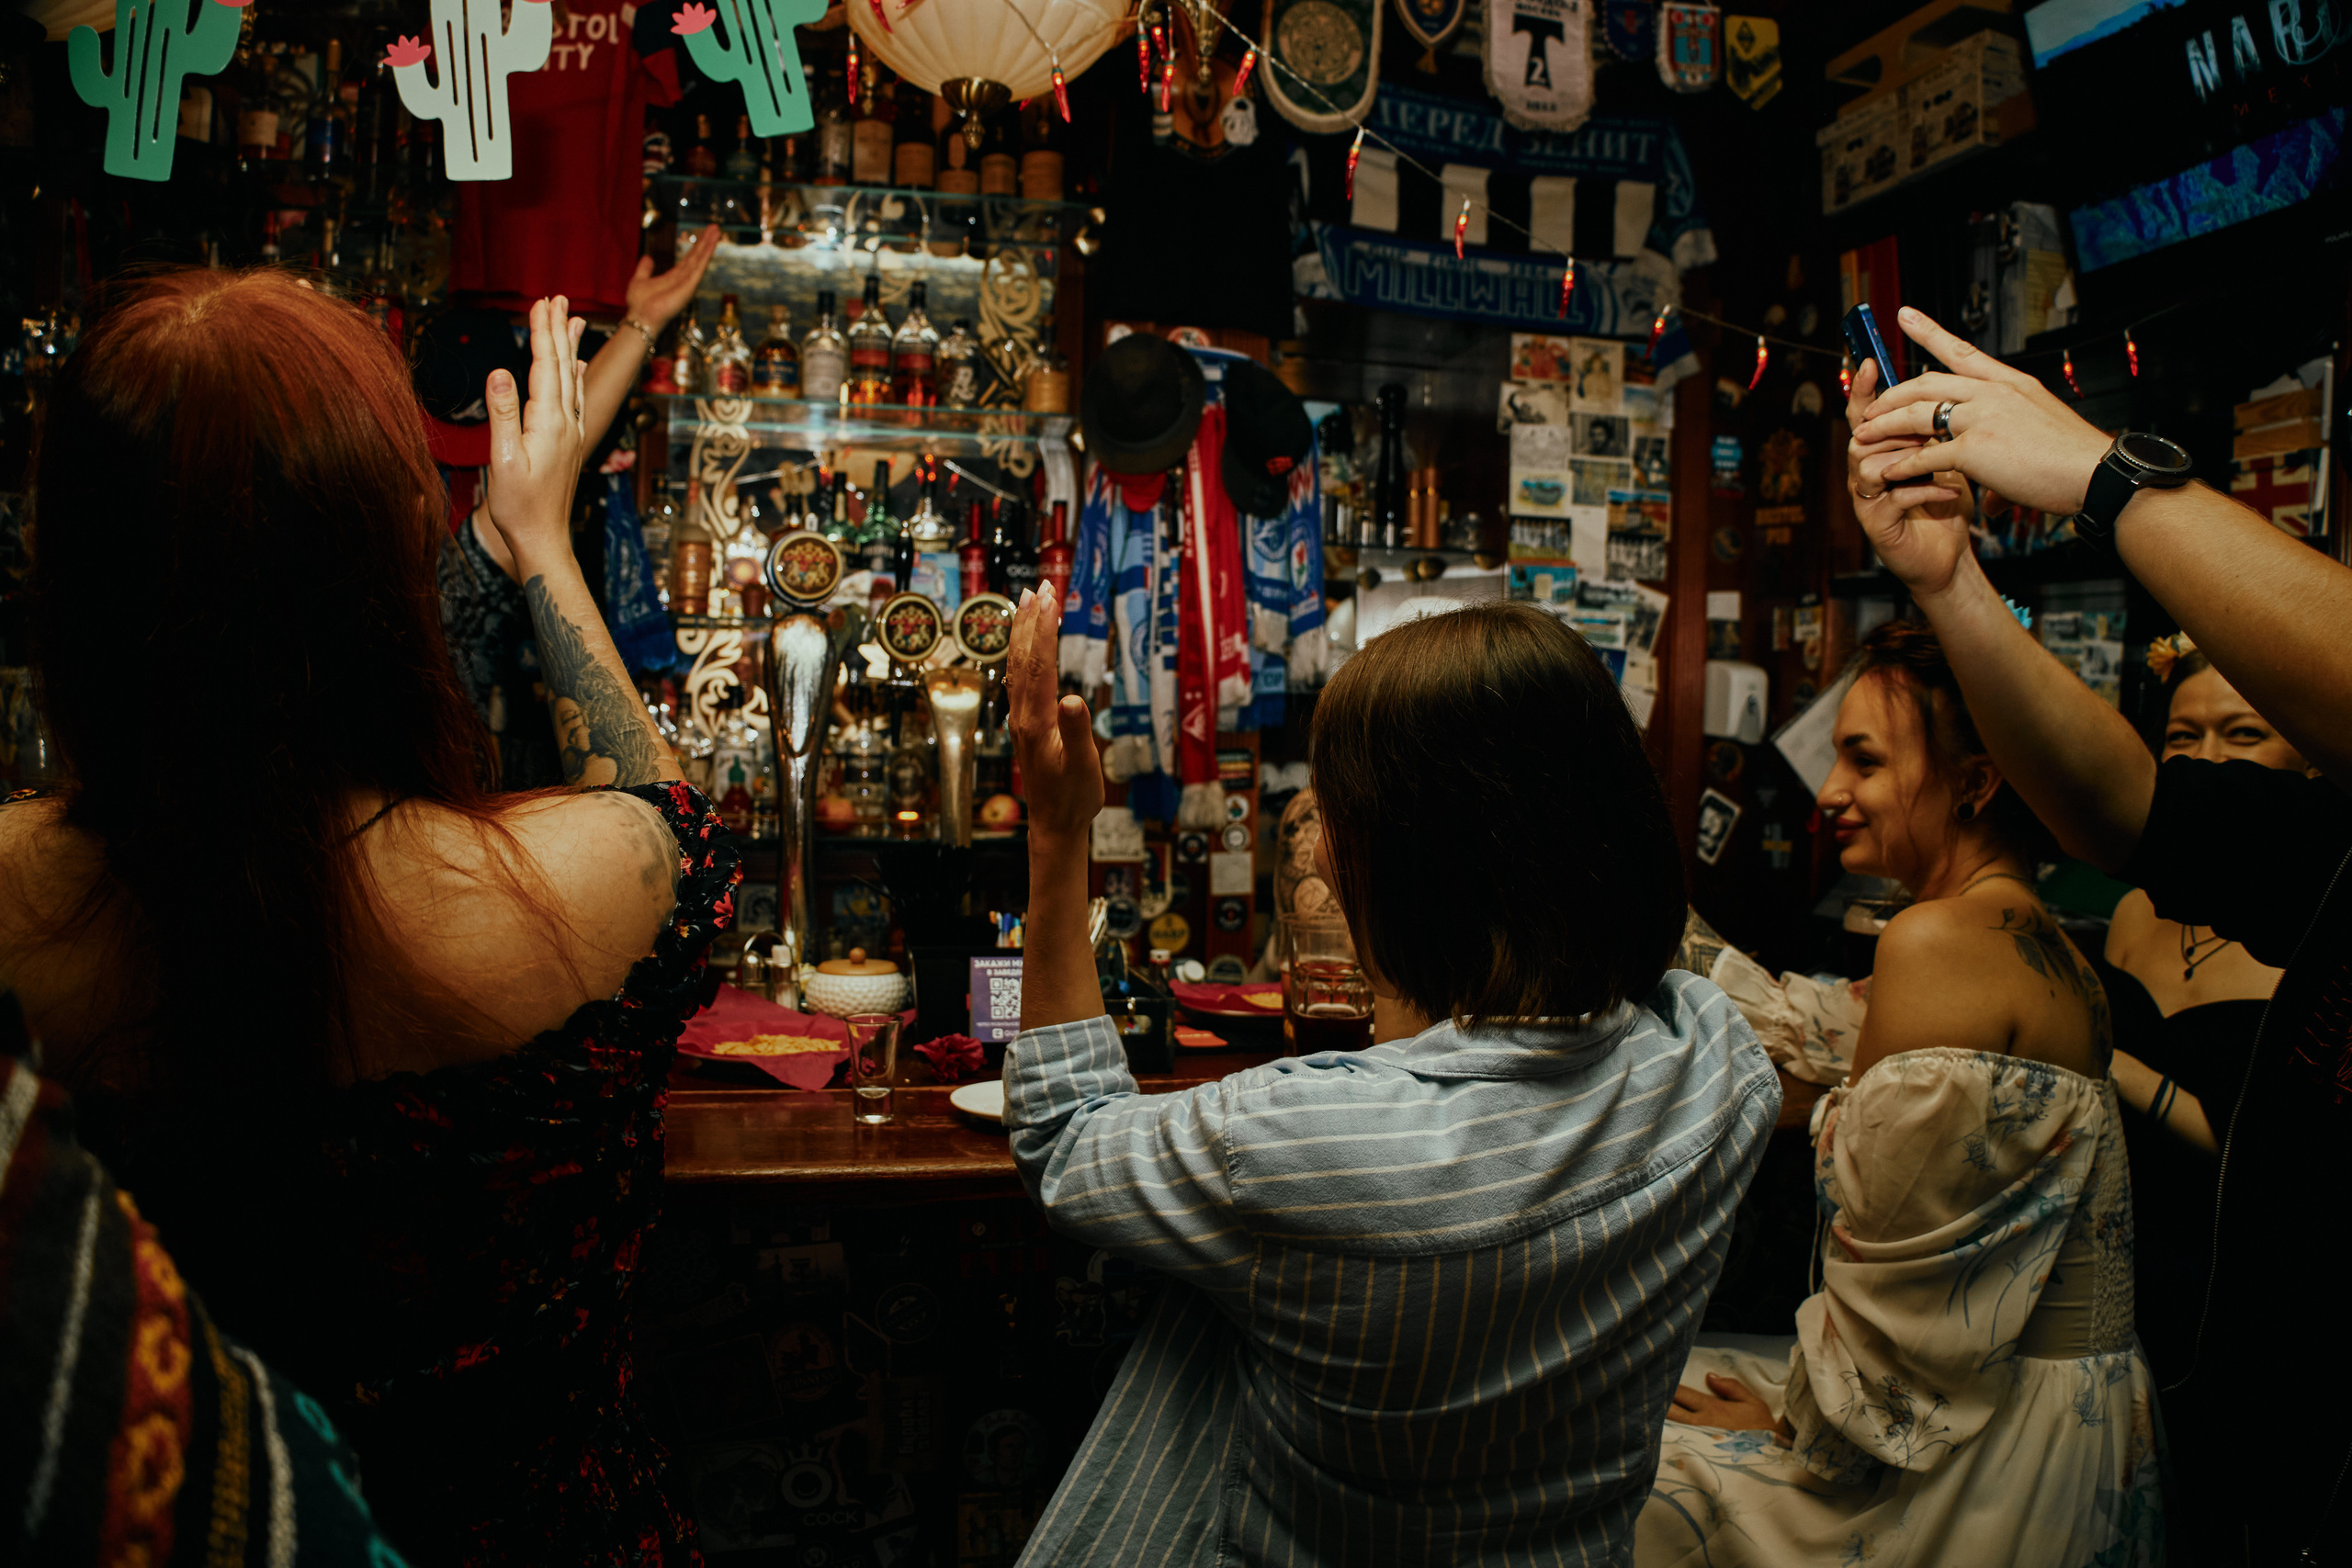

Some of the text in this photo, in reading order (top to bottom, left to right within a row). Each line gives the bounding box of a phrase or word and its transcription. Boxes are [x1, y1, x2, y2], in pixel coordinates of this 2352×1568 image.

[1378, 95, 1506, 156] ЕРЕД
[1344, 245, 1586, 323] MILLWALL
[974, 959, 1011, 968] ЗАКАЖИ
[803, 1511, 858, 1527] COCK
